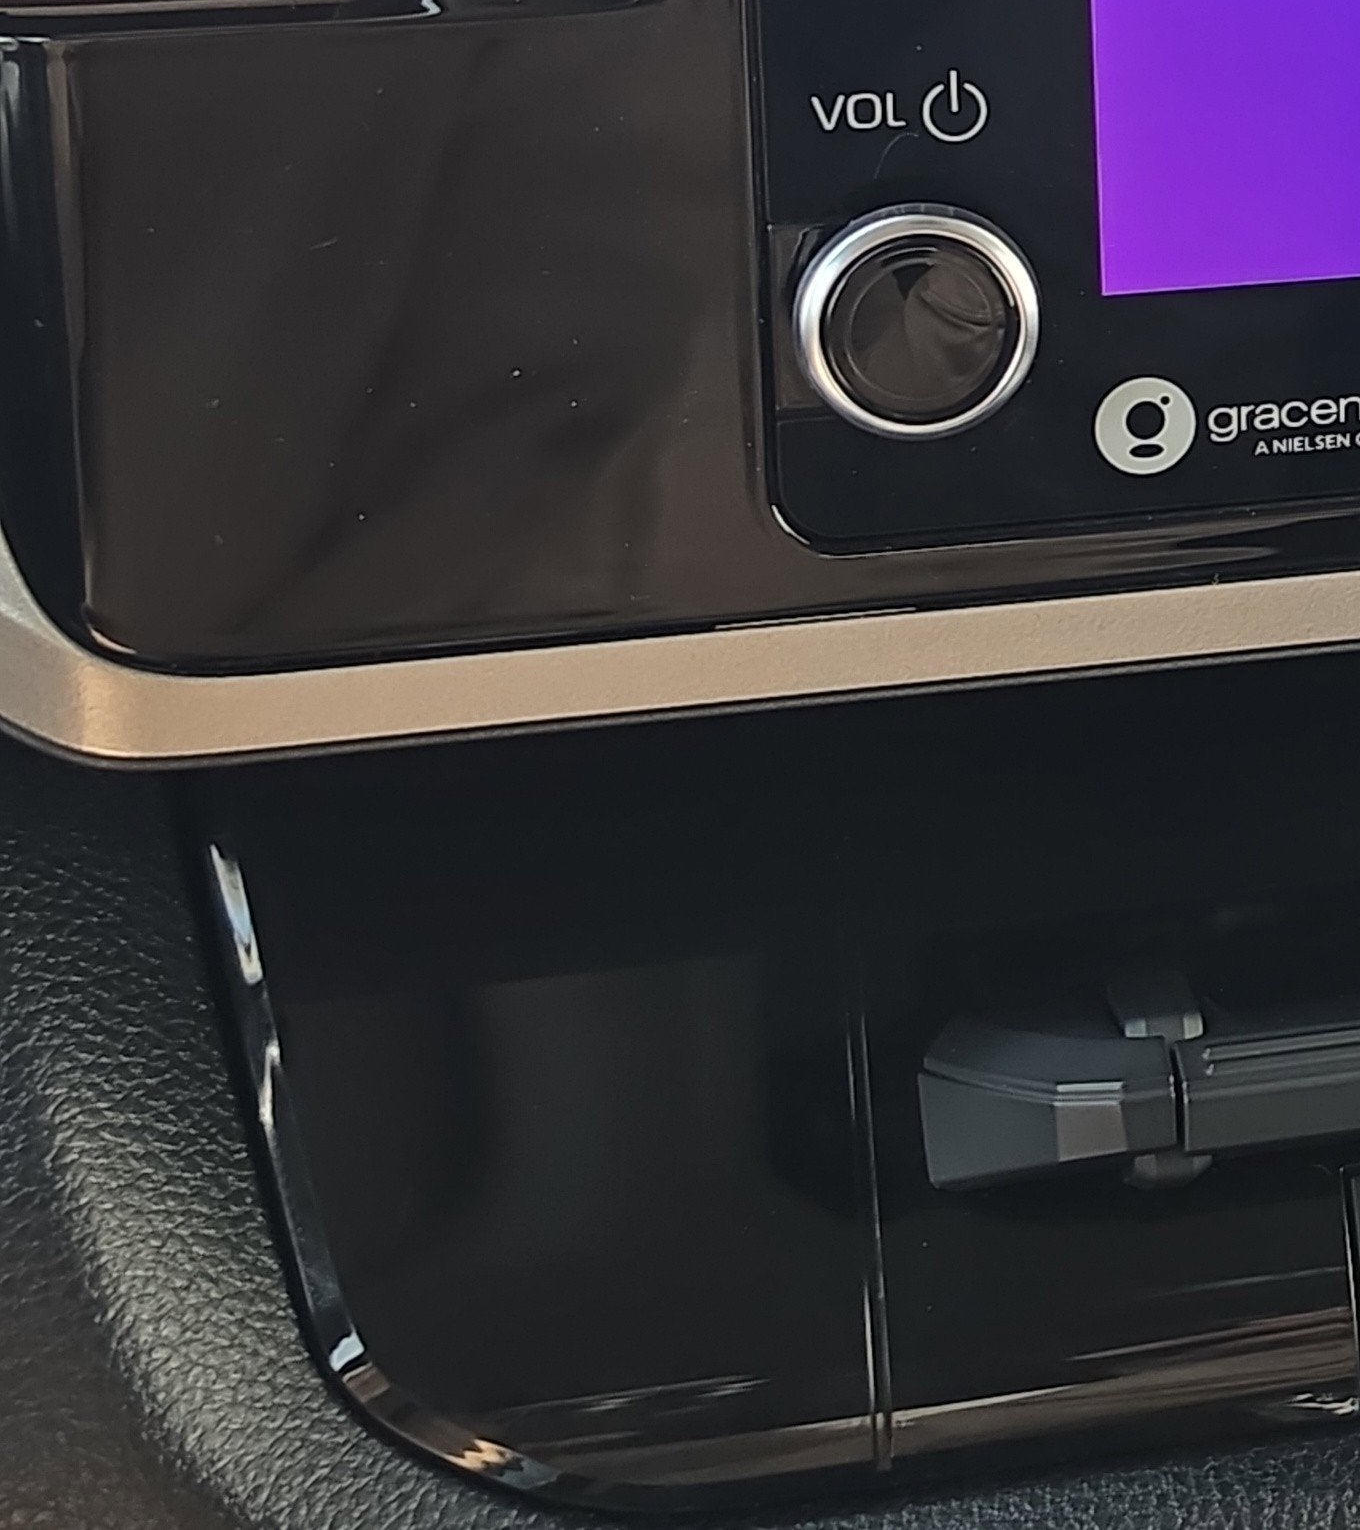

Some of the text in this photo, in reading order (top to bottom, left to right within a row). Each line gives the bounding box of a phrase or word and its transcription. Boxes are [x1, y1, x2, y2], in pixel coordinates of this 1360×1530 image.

[811, 92, 906, 131] VOL
[1255, 441, 1269, 456] A
[1272, 432, 1351, 454] NIELSEN
